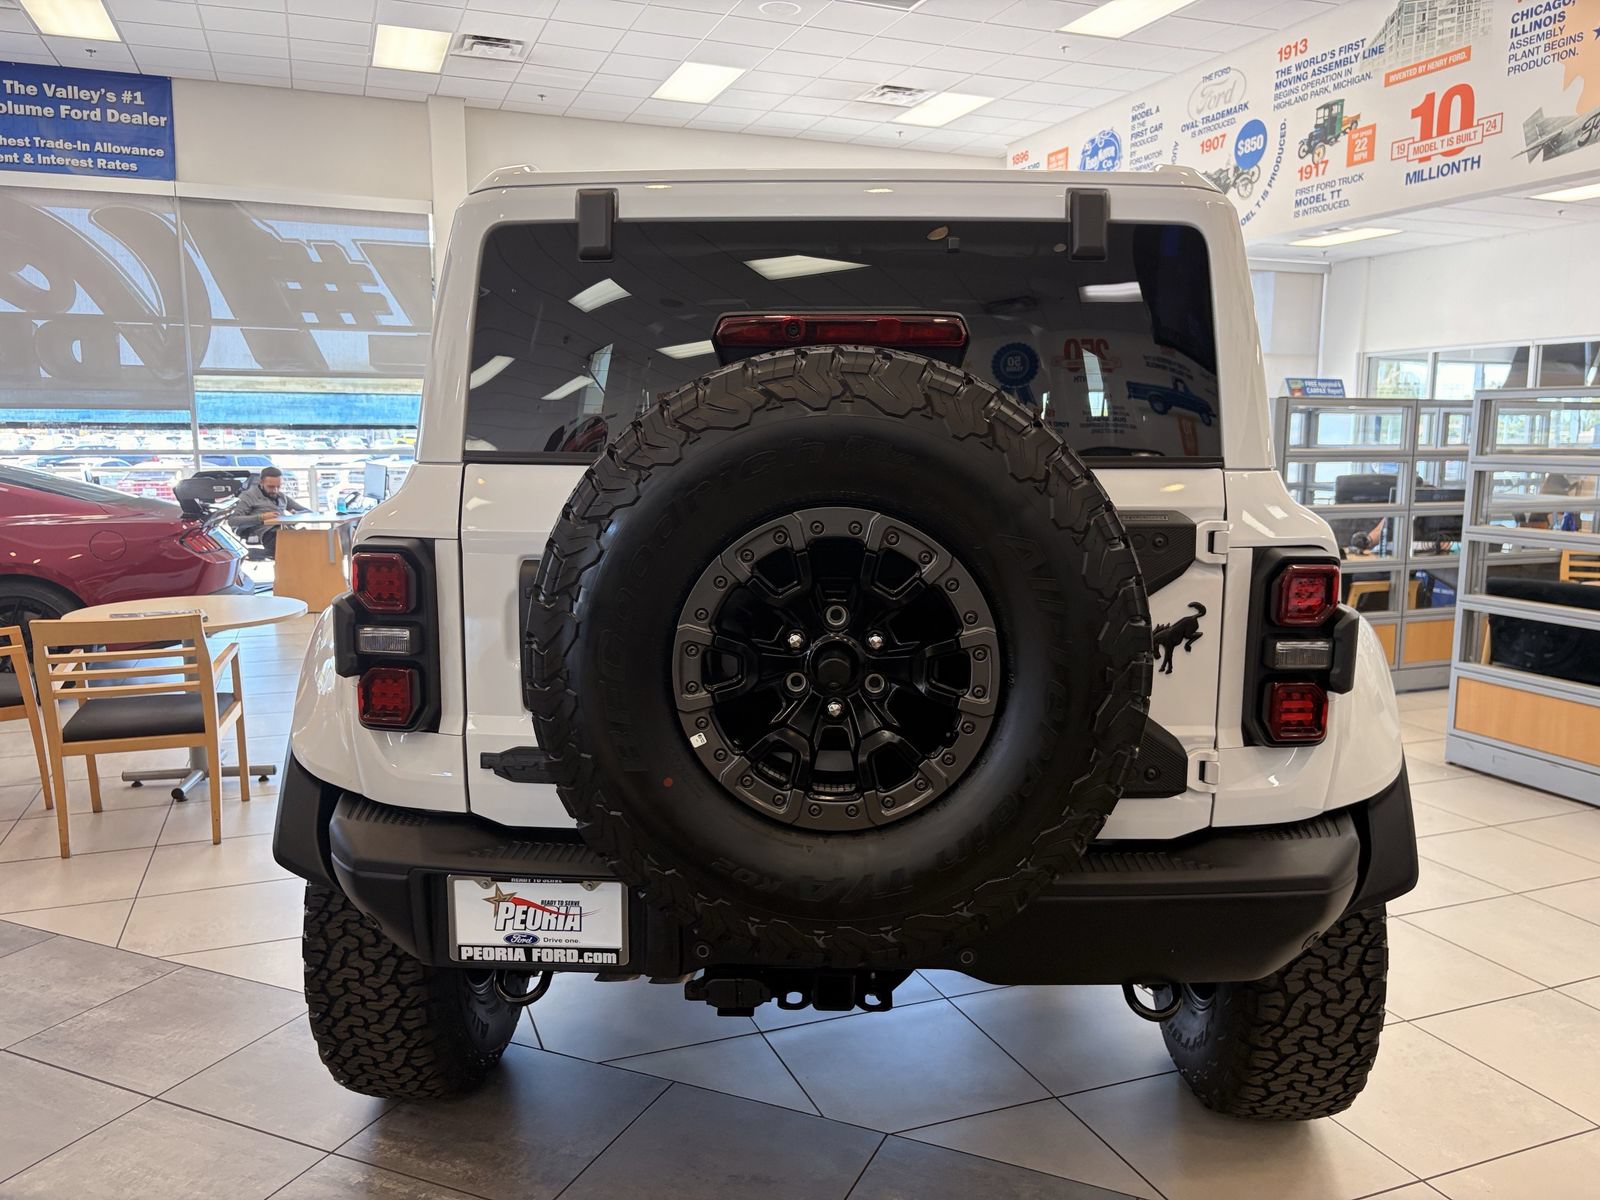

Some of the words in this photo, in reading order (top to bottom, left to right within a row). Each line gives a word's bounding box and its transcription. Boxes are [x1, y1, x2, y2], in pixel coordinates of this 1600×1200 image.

[1510, 11, 1566, 39] ILLINOIS
[1277, 38, 1308, 62] 1913
[1508, 25, 1566, 52] ASSEMBLY
[1508, 45, 1541, 64] PLANT
[1543, 31, 1584, 53] BEGINS
[1274, 71, 1309, 91] MOVING
[1310, 53, 1360, 78] ASSEMBLY
[1362, 44, 1386, 60] LINE
[1275, 65, 1293, 79] THE
[1294, 49, 1336, 71] WORLD'S
[1338, 38, 1367, 57] FIRST
[1389, 68, 1418, 83] INVENTED
[1418, 64, 1427, 74] BY
[1427, 57, 1448, 71] HENRY
[1507, 47, 1579, 76] PRODUCTION.
[1202, 73, 1213, 83] THE
[1214, 67, 1231, 79] FORD
[1273, 86, 1300, 102] BEGINS
[1300, 71, 1343, 92] OPERATION
[1344, 67, 1353, 77] IN
[3, 80, 38, 96] The
[43, 83, 117, 104] Valley's
[121, 91, 145, 106] #1
[1196, 78, 1237, 115] Ford
[1273, 92, 1309, 112] HIGHLAND
[1332, 72, 1373, 91] MICHIGAN.
[60, 105, 101, 122] Ford
[107, 109, 168, 128] Dealer
[1131, 107, 1153, 122] MODEL
[1155, 105, 1160, 114] A
[1181, 120, 1198, 133] OVAL
[1201, 101, 1250, 126] TRADEMARK
[1411, 83, 1475, 163] 10
[1131, 127, 1148, 141] FIRST
[1149, 122, 1163, 134] CAR
[1191, 130, 1196, 139] IS
[1485, 119, 1497, 133] 24
[33, 136, 91, 152] Trade-In
[94, 142, 165, 158] Allowance
[1130, 134, 1158, 149] PRODUCED
[1200, 133, 1227, 155] 1907
[1237, 134, 1264, 157] $850
[1354, 137, 1368, 153] 22
[1396, 143, 1406, 156] 19
[1412, 142, 1439, 156] MODEL
[1440, 139, 1445, 149] T
[1446, 136, 1454, 147] IS
[1456, 130, 1478, 145] BUILT
[23, 153, 35, 164] &
[37, 153, 93, 169] Interest
[97, 158, 138, 172] Rates
[1130, 156, 1143, 167] FORD
[1144, 150, 1163, 161] MOTOR
[1267, 118, 1288, 189] PRODUCED.
[1298, 160, 1329, 181] 1917
[1405, 155, 1482, 186] MILLIONTH
[1295, 184, 1315, 197] FIRST
[1315, 179, 1336, 191] FORD
[1337, 172, 1364, 186] TRUCK
[1294, 210, 1300, 218] IS
[1301, 198, 1351, 217] INTRODUCED.
[1295, 193, 1326, 208] MODEL
[1330, 189, 1342, 200] TT
[494, 901, 582, 932] PEORIA
[510, 934, 533, 944] Ford
[461, 946, 526, 962] PEORIA
[532, 948, 617, 964] FORD.com
